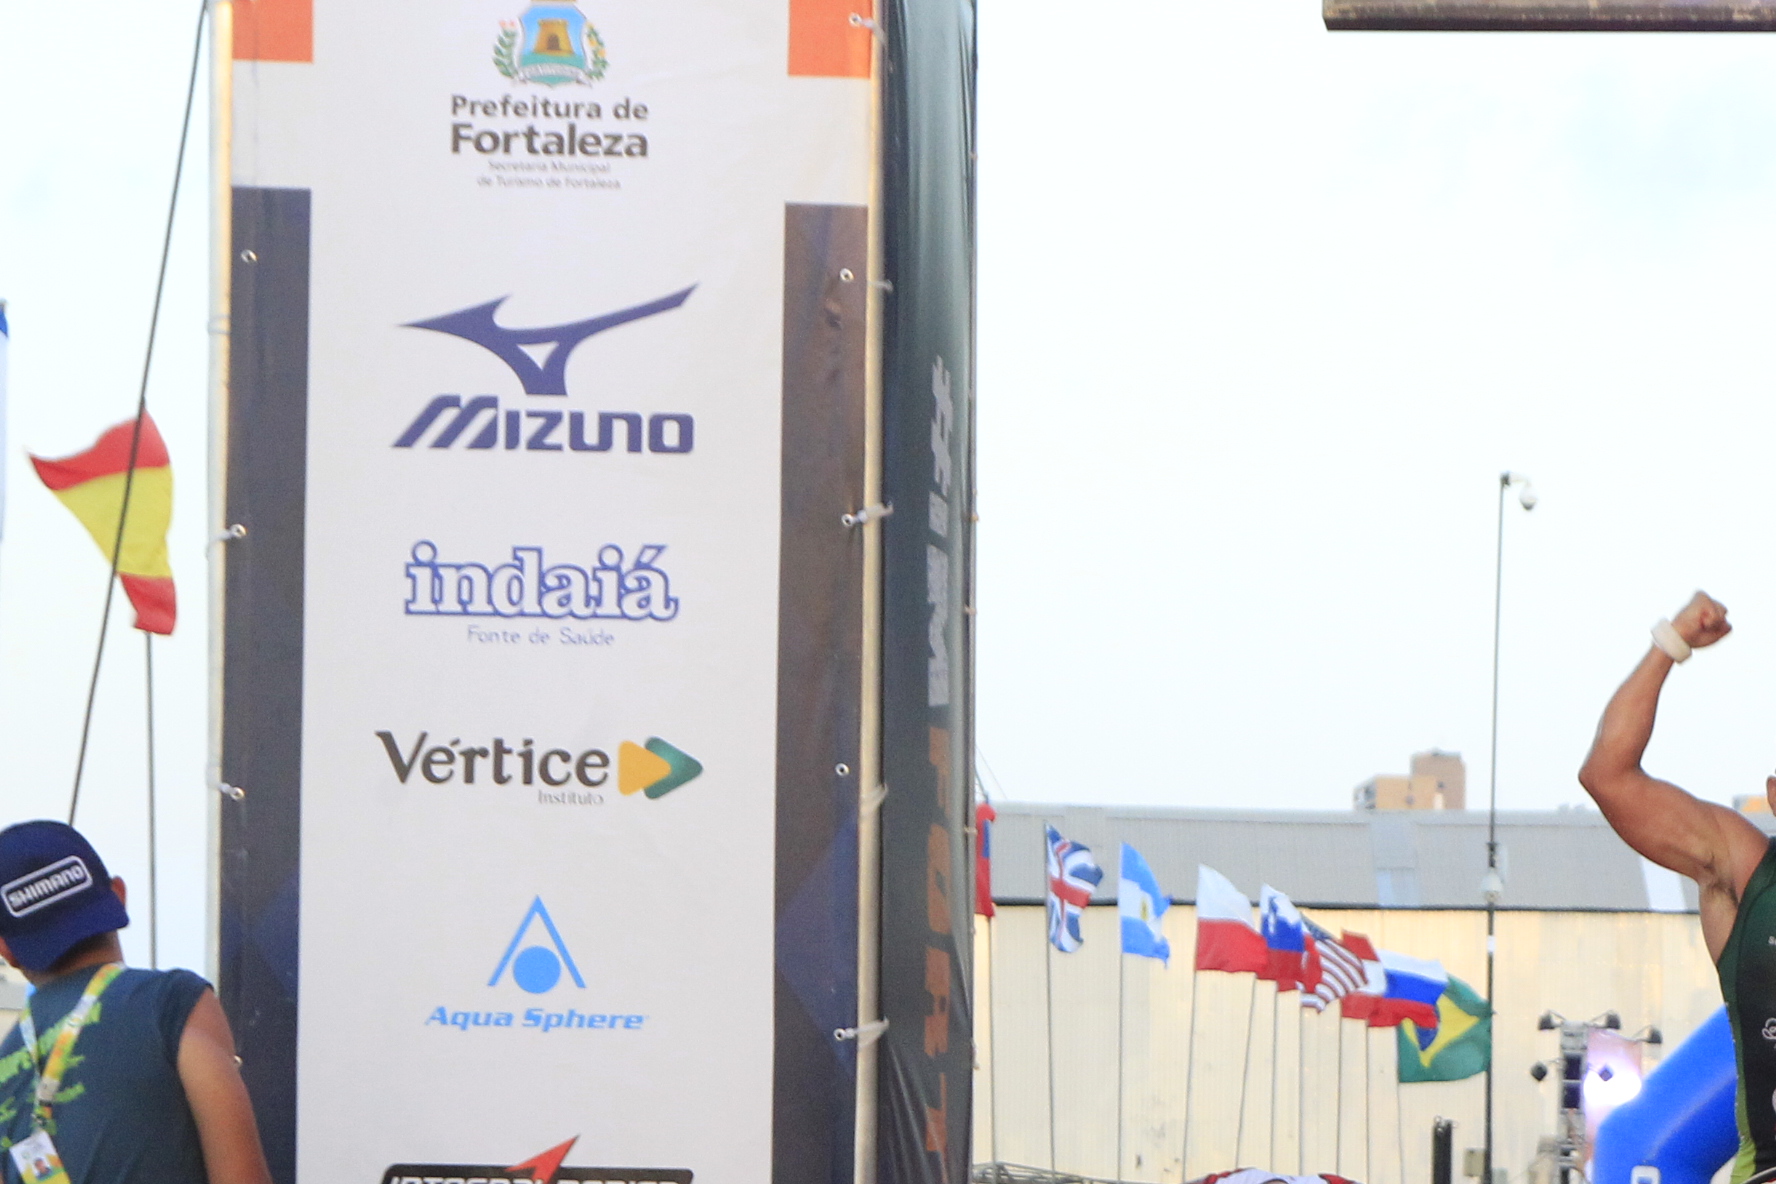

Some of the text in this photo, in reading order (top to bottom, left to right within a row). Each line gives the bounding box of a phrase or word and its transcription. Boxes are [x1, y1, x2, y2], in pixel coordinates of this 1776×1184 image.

[451, 95, 648, 119] Prefeitura de
[451, 123, 648, 156] Fortaleza
[489, 161, 609, 173] Secretaria Municipal
[565, 177, 620, 188] Fortaleza
[404, 540, 679, 621] indaiá
[468, 625, 615, 645] Fonte de Saúde
[375, 731, 610, 787] Vértice
[538, 790, 604, 805] Instituto
[8, 865, 85, 908] SHIMANO
[426, 1006, 644, 1032] Aqua Sphere
